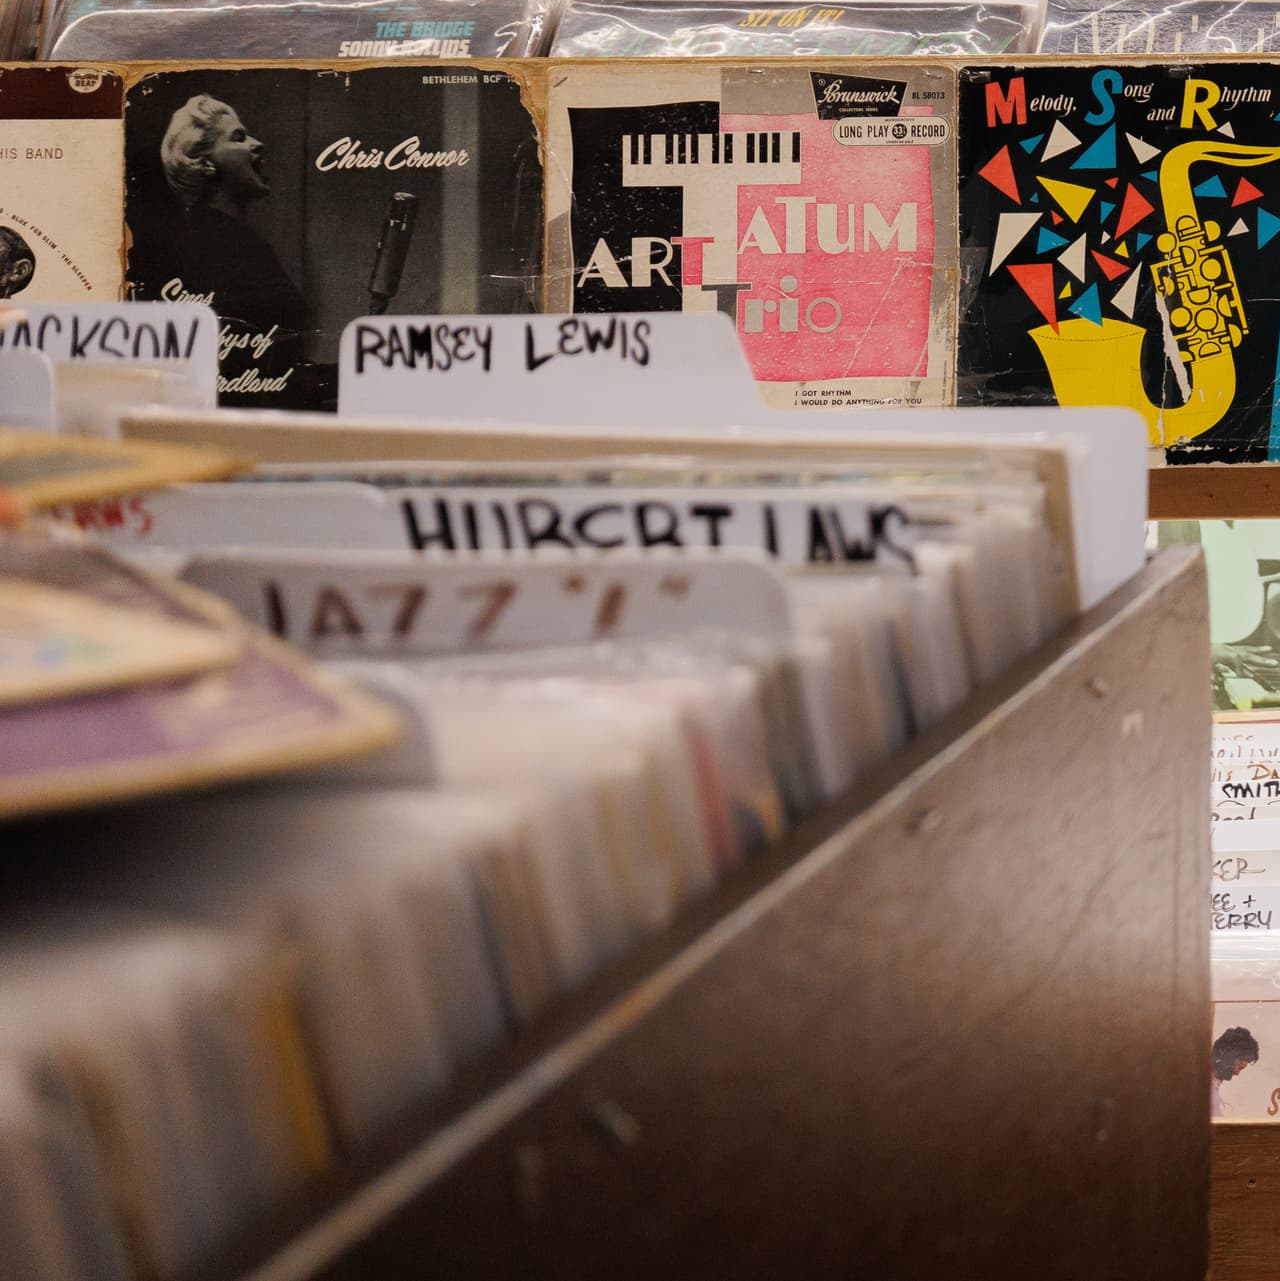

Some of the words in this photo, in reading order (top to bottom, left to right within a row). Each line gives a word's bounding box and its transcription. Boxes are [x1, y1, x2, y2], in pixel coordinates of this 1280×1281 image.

[376, 20, 409, 37] THE
[411, 20, 476, 38] BRIDGE
[74, 79, 97, 88] BEAT
[422, 74, 478, 84] BETHLEHEM
[817, 78, 901, 105] Brunswick
[1085, 68, 1154, 126] Song
[1147, 106, 1175, 122] and
[1179, 78, 1272, 132] Rhythm
[839, 125, 863, 139] LONG
[867, 125, 889, 138] PLAY
[910, 124, 946, 139] RECORD
[25, 147, 64, 160] BAND
[315, 134, 384, 173] Chris
[386, 134, 472, 173] Connor
[11, 214, 28, 228] BLUE
[29, 225, 43, 239] FOR
[42, 235, 57, 250] SLIM
[60, 253, 73, 267] THE
[576, 236, 715, 288] ART
[355, 322, 494, 376] RAMSEY
[524, 318, 653, 372] LEWIS
[821, 389, 852, 397] RHYTHM
